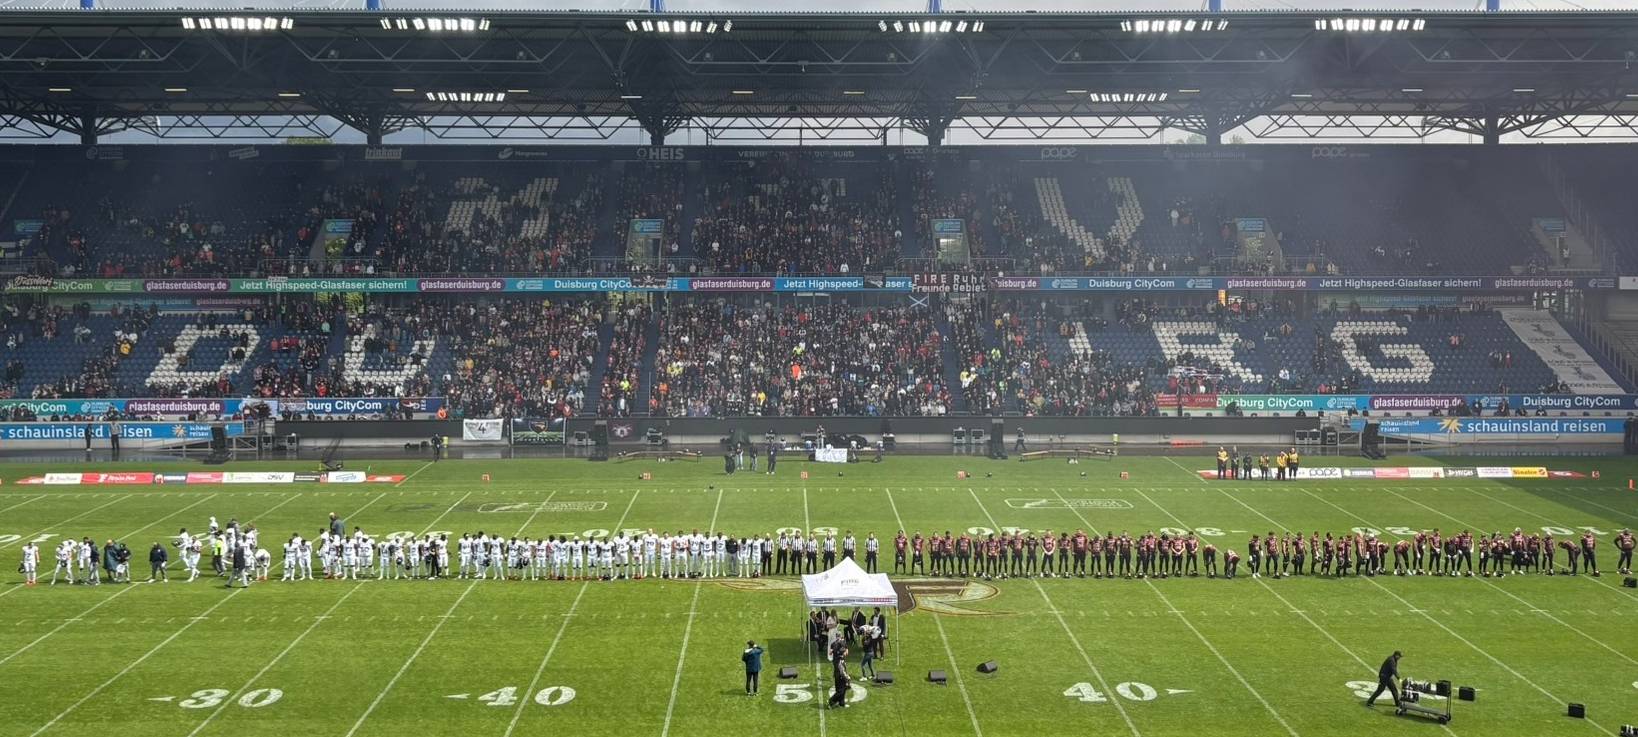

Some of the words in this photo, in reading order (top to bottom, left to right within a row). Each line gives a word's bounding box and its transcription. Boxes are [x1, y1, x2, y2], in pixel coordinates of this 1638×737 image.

[784, 279, 806, 289] Jetzt
[914, 274, 947, 283] FIRE
[1320, 279, 1342, 288] Jetzt
[1345, 279, 1442, 290] Highspeed-Glasfaser
[1444, 278, 1481, 288] sichern!
[1495, 279, 1573, 289] glasfaserduisburg.de
[146, 281, 227, 292] glasfaserduisburg.de
[240, 281, 263, 290] Jetzt
[267, 281, 365, 293] Highspeed-Glasfaser
[369, 281, 407, 290] sichern!
[421, 281, 501, 291] glasfaserduisburg.de
[555, 280, 597, 291] Duisburg
[600, 280, 632, 291] CityCo
[693, 280, 770, 291] glasfaserduisburg.de
[911, 283, 950, 292] Freunde
[1089, 279, 1131, 290] Duisburg
[1134, 279, 1175, 290] CityCom
[1227, 279, 1306, 290] glasfaserduisburg.de
[335, 400, 381, 412] CityCom
[1267, 397, 1313, 409] CityCom
[1523, 396, 1571, 408] Duisburg
[1575, 396, 1620, 408] CityCom
[1467, 419, 1559, 432] schauinsland
[1563, 420, 1606, 432] reisen
[9, 425, 103, 438] schauinslad
[478, 686, 576, 706] 40
[1062, 682, 1158, 702] 40
[179, 688, 284, 708] 30
